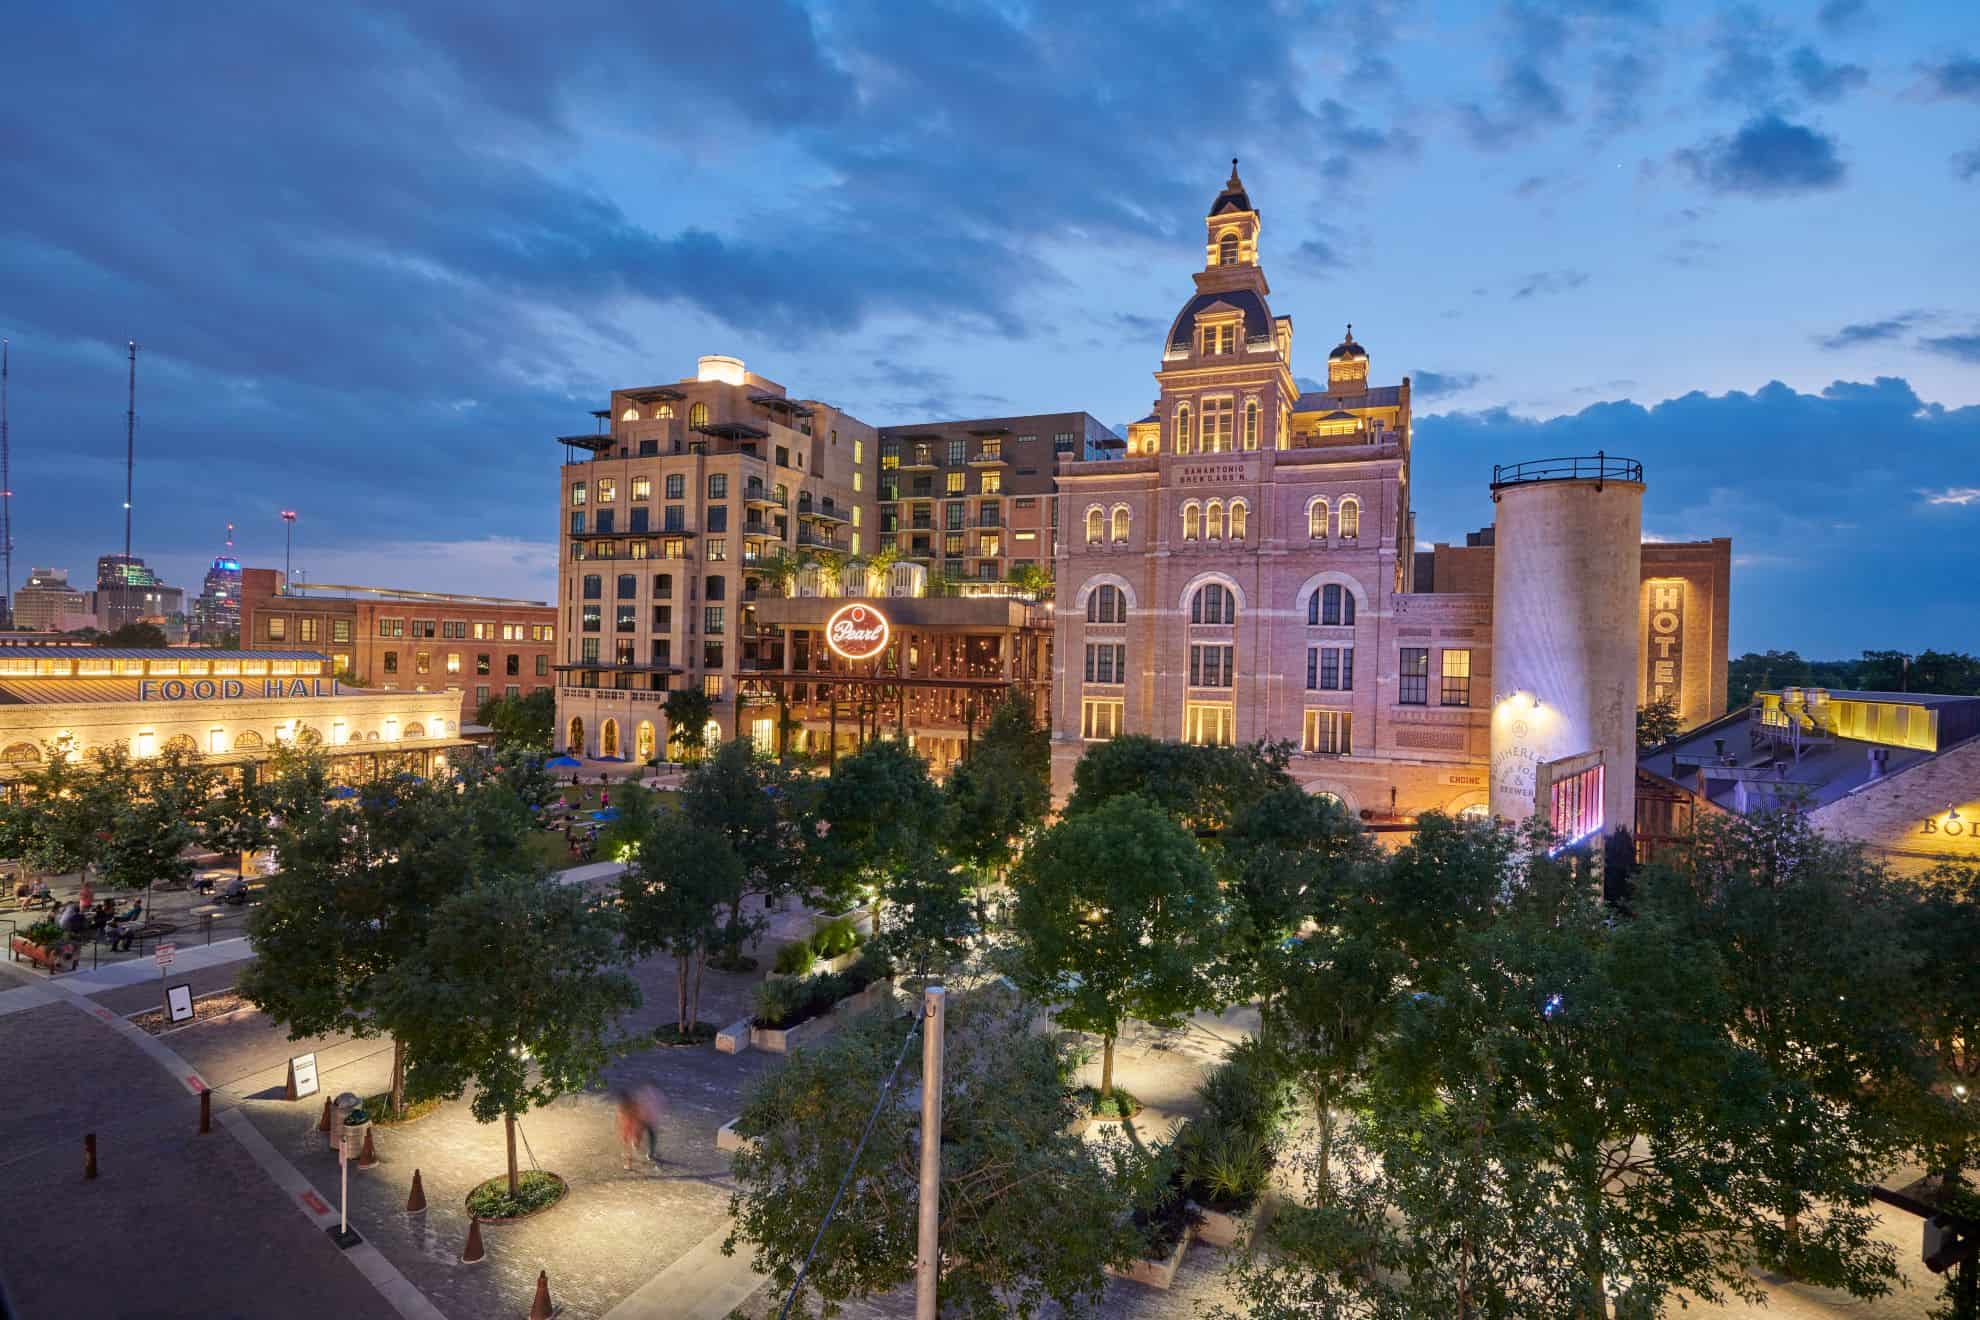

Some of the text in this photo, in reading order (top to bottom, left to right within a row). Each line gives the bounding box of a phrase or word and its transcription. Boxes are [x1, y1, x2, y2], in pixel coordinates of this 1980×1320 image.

[833, 620, 884, 642] Pearl
[138, 678, 346, 701] FOOD HALL
